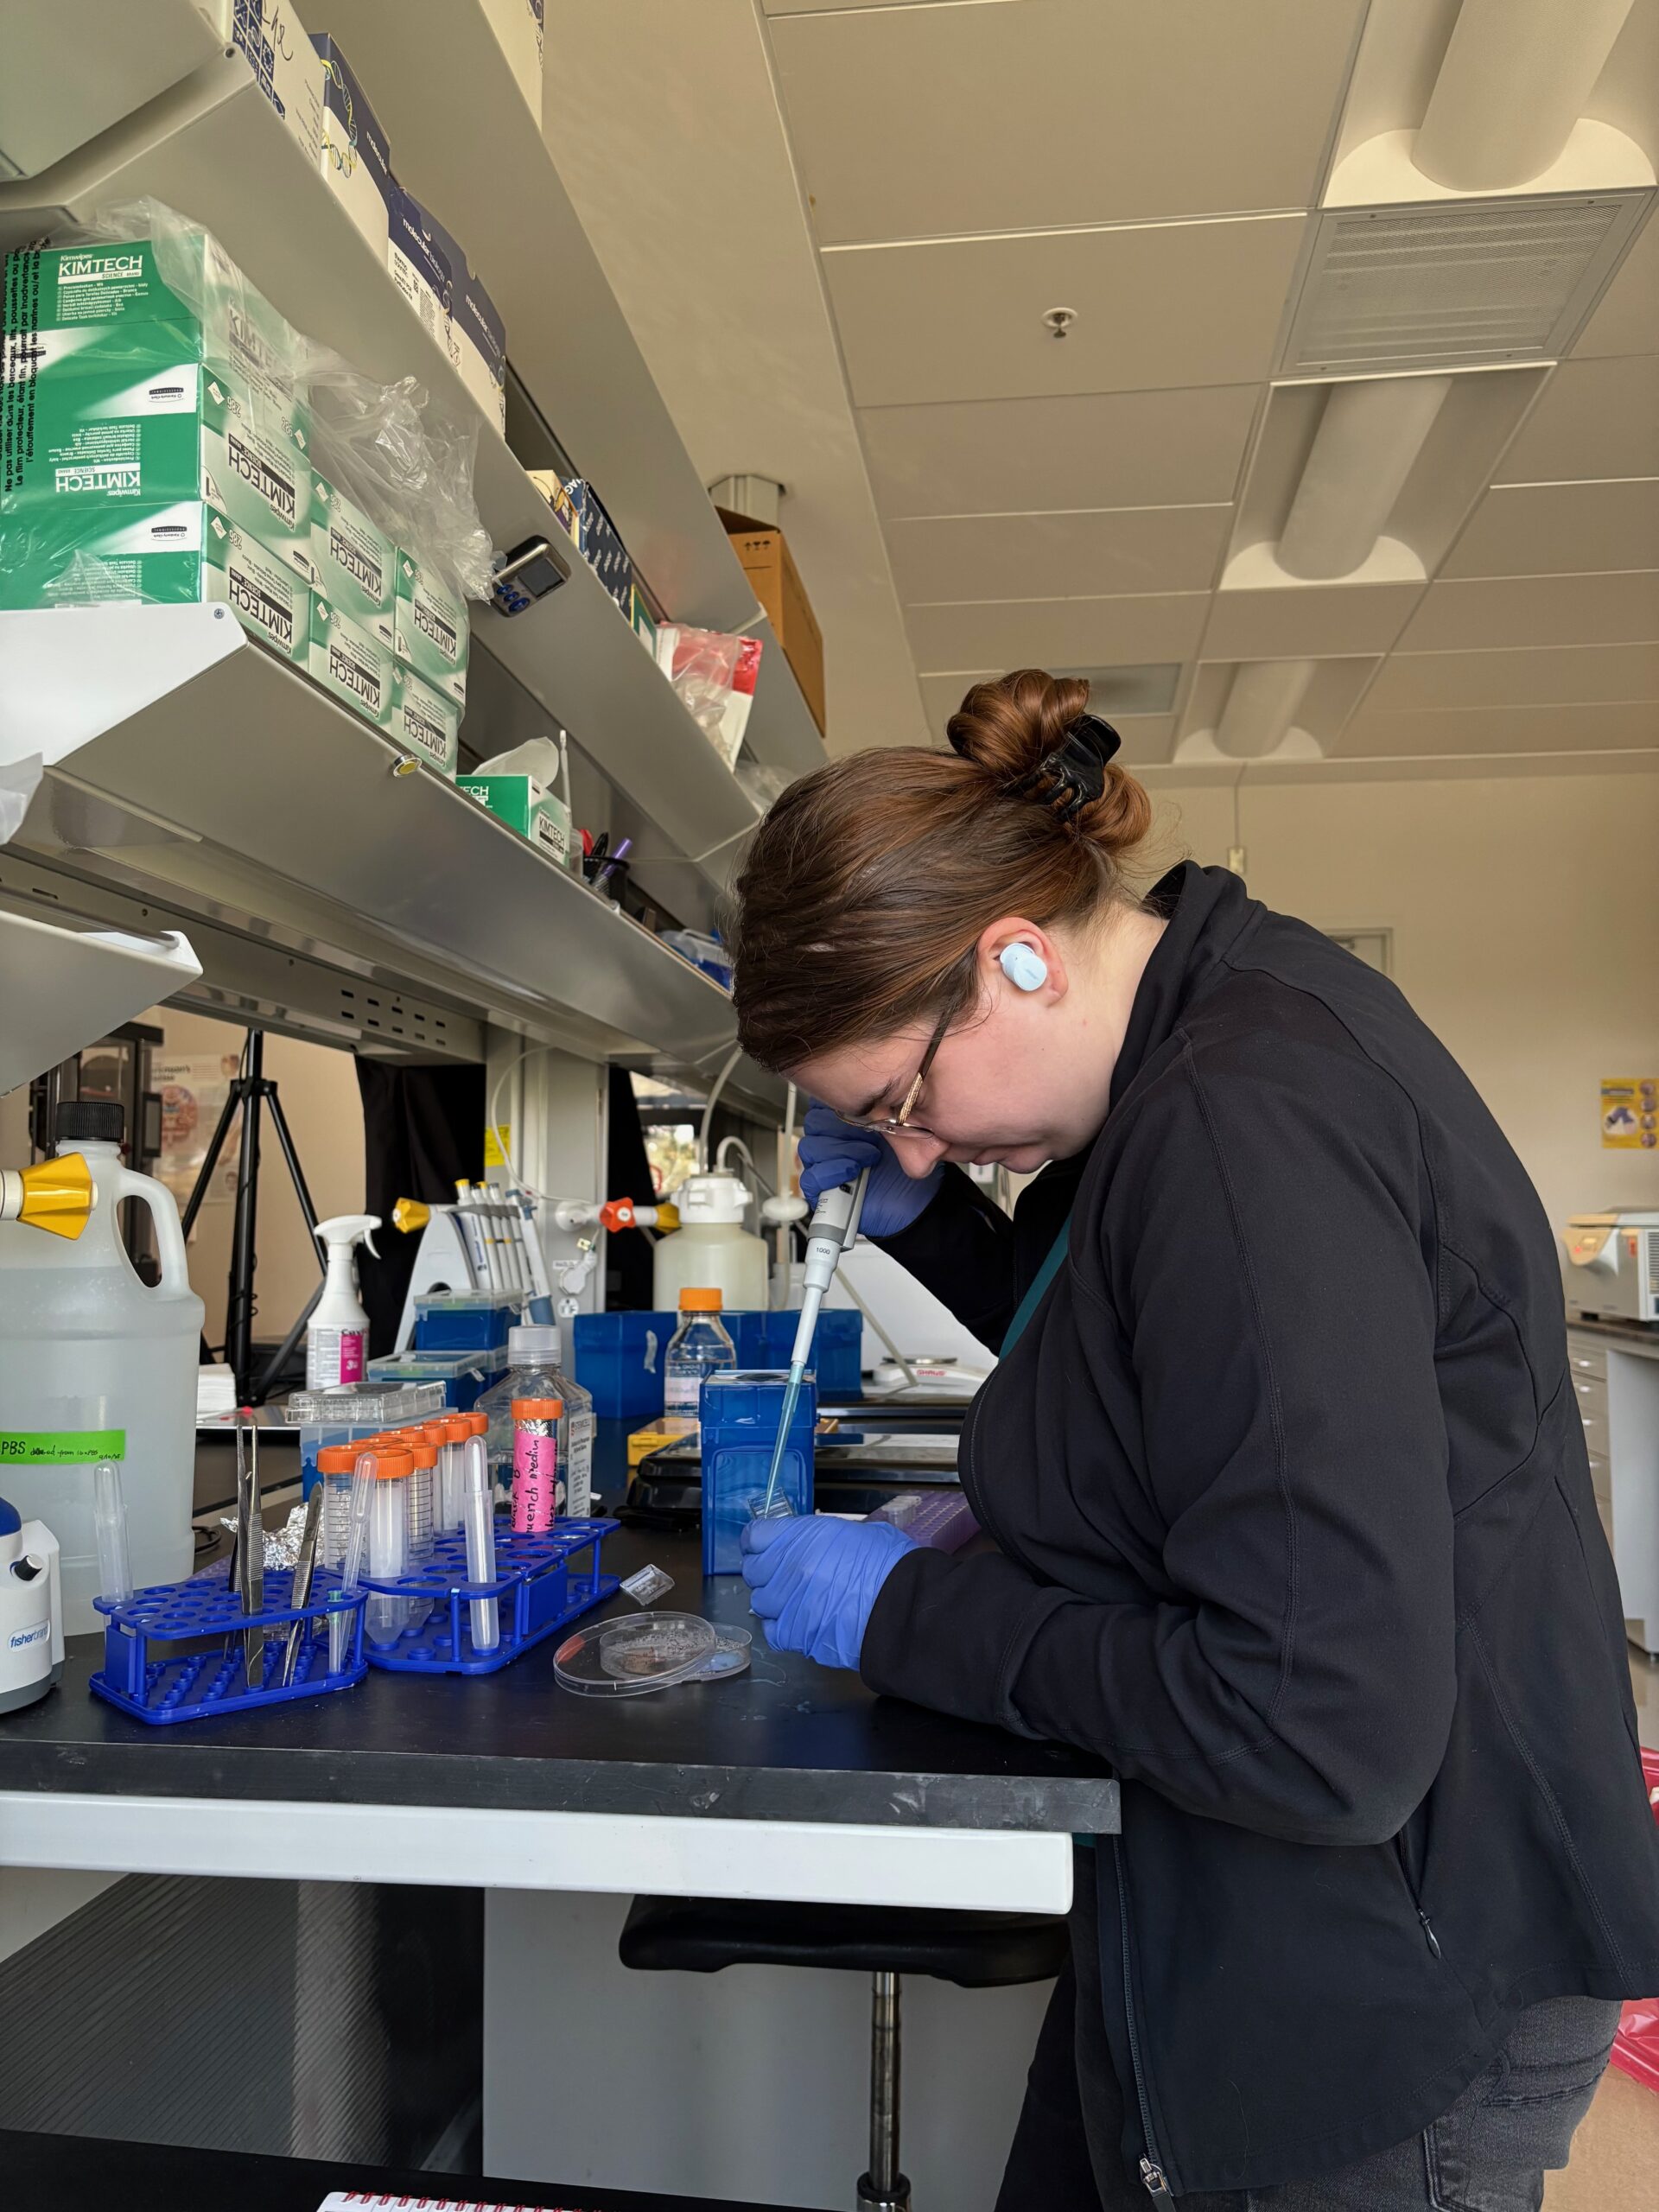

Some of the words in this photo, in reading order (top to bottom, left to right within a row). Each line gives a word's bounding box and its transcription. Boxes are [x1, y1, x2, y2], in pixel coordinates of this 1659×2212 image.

[403, 218, 430, 257] molecular
[12, 264, 18, 276] ou
[59, 255, 143, 276] KIMTECH
[10, 276, 18, 324] poussettes
[16, 381, 25, 404] étant
[29, 390, 35, 401] en
[16, 404, 25, 454] protecteur,
[26, 403, 35, 463] l'étouffement
[5, 479, 12, 492] Ne
[16, 475, 23, 486] Le
[55, 471, 141, 493] KIMTECH
[106, 488, 141, 497] Kimwipes
[229, 446, 295, 519] KIMTECH
[330, 537, 381, 597] KIMTECH
[229, 579, 292, 643] KIMTECH
[414, 607, 456, 658] KIMTECH
[329, 655, 380, 709] KIMTECH
[404, 715, 446, 758] KIMTECH
[1, 1440, 26, 1455] PBS
